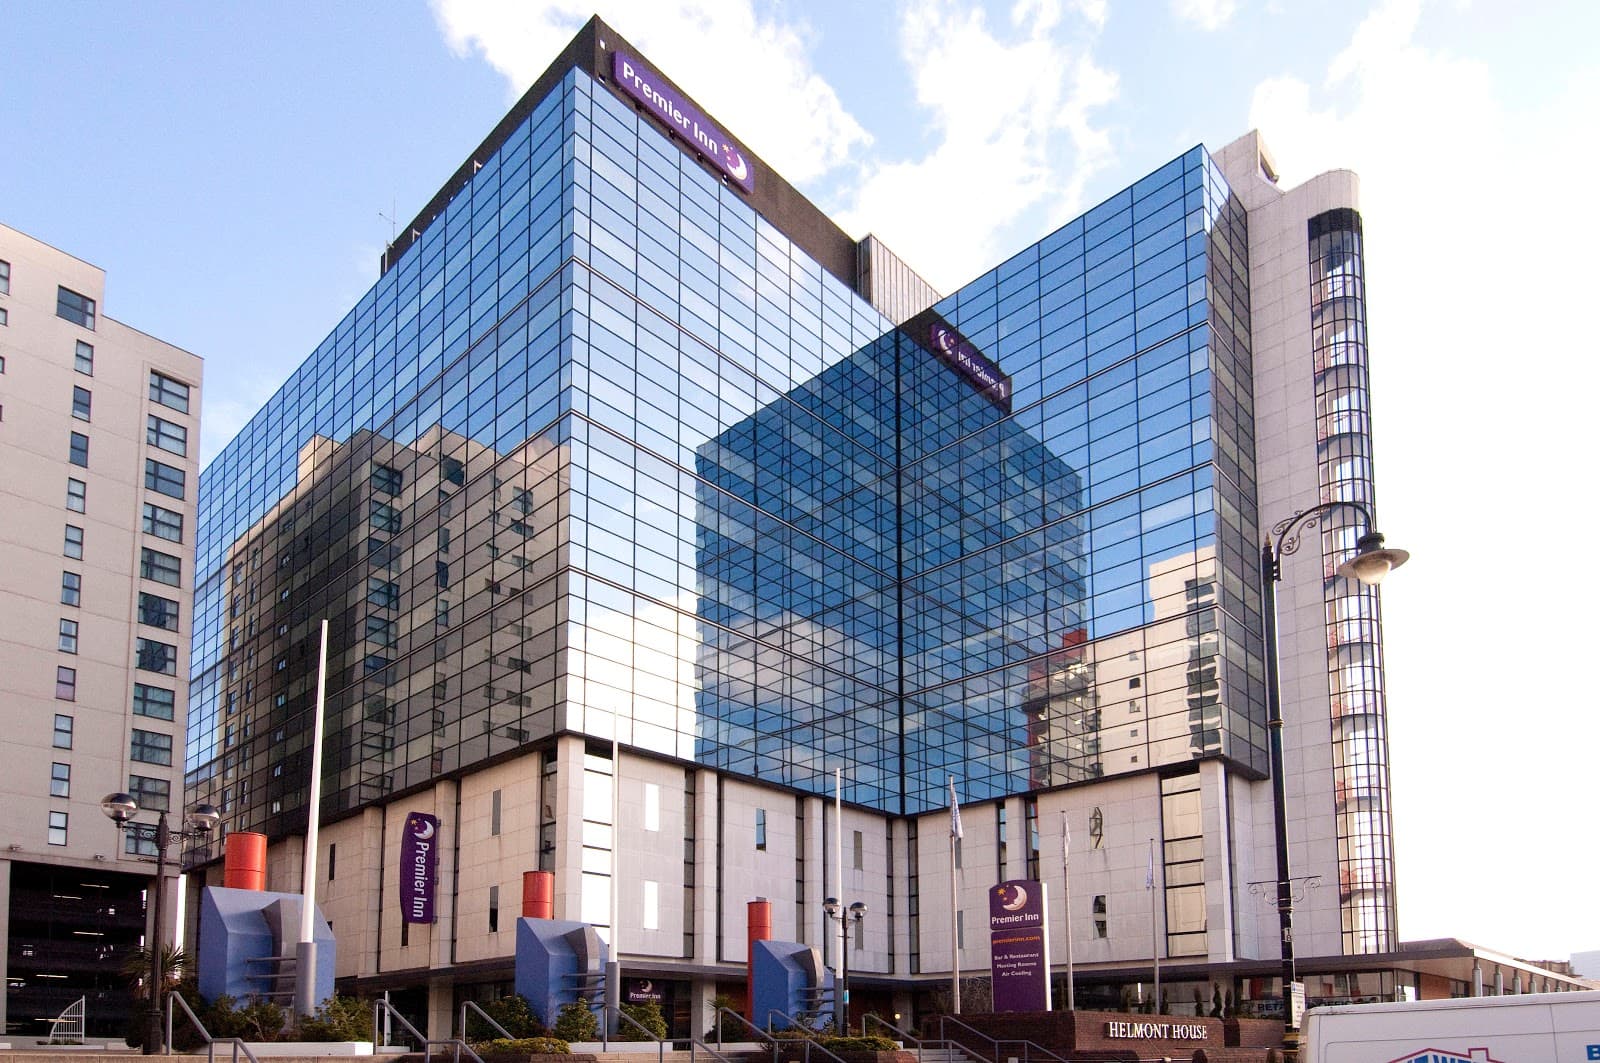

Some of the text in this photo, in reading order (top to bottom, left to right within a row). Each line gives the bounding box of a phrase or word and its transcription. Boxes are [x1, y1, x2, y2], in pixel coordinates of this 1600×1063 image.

[623, 61, 718, 155] Premier Inn
[412, 841, 430, 918] Premier Inn
[991, 912, 1039, 925] Premier Inn
[992, 935, 1040, 944] premierinn.com
[1108, 1022, 1208, 1040] HELMONT HOUSE
